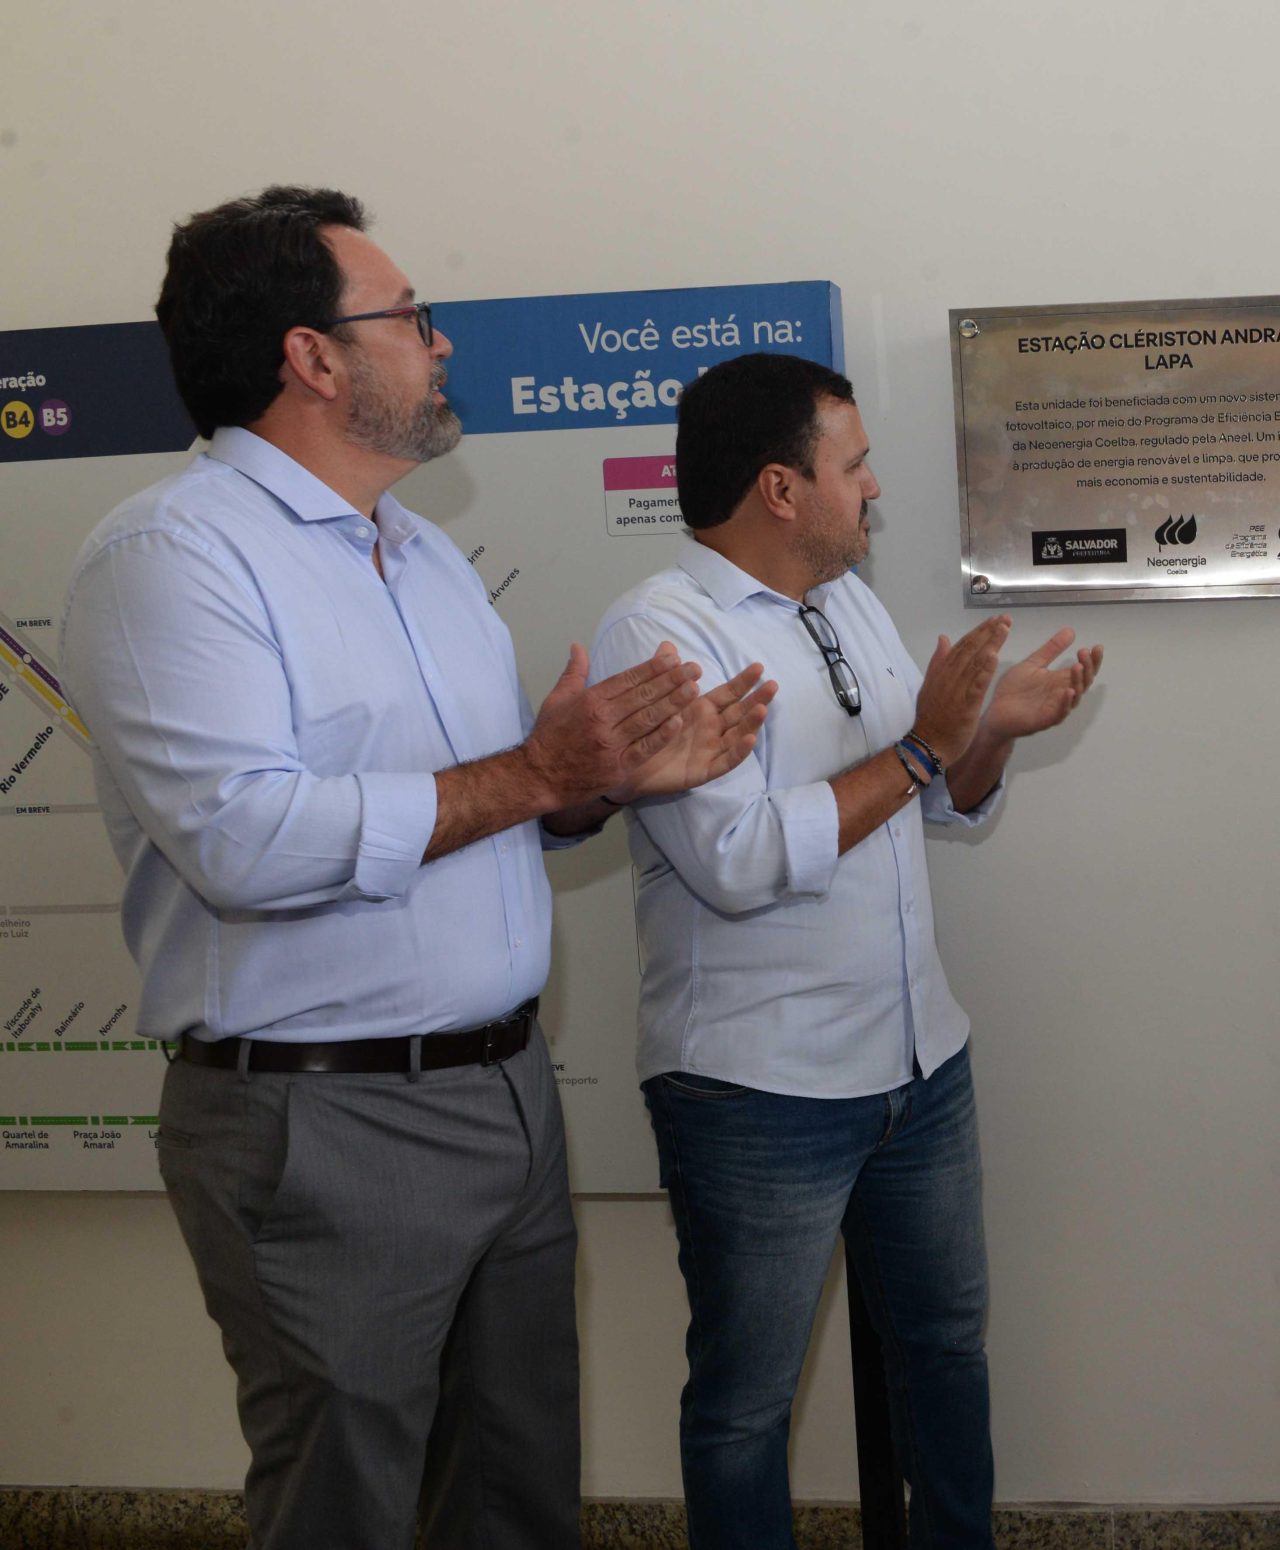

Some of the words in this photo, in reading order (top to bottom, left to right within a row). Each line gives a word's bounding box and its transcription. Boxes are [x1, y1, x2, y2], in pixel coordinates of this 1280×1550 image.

[578, 318, 660, 353] Você
[671, 314, 741, 349] está
[753, 320, 802, 345] na:
[1018, 332, 1104, 354] ESTAÇÃO
[1109, 329, 1217, 349] CLÉRISTON
[1144, 354, 1193, 370] LAPA
[510, 369, 684, 420] Estação
[1015, 401, 1040, 411] Esta
[1042, 398, 1086, 409] unidade
[1089, 397, 1103, 408] foi
[1105, 395, 1170, 408] beneficiada
[1172, 396, 1197, 405] com
[1200, 395, 1217, 404] um
[1219, 394, 1247, 403] novo
[5, 410, 31, 429] B4
[42, 407, 68, 427] B5
[1006, 419, 1074, 431] fotovoltaico,
[1076, 420, 1095, 430] por
[1098, 418, 1125, 428] meio
[1127, 416, 1142, 426] do
[1144, 415, 1198, 427] Programa
[1200, 413, 1215, 423] de
[1217, 411, 1272, 423] Eficiência
[1012, 441, 1027, 451] da
[1029, 438, 1093, 450] Neoenergia
[1095, 436, 1138, 448] Coelba,
[1140, 434, 1189, 447] regulado
[1192, 434, 1216, 445] pela
[1219, 432, 1254, 443] Aneel.
[1256, 432, 1275, 442] Um
[1022, 459, 1075, 472] produção
[1077, 458, 1092, 468] de
[1094, 456, 1135, 468] energia
[1137, 453, 1191, 466] renovável
[1193, 455, 1200, 464] e
[1238, 453, 1260, 464] que
[1076, 476, 1103, 488] mais
[1104, 475, 1159, 487] economia
[1161, 476, 1169, 484] e
[1171, 471, 1266, 484] sustentabilidade.
[616, 514, 656, 527] apenas
[1065, 539, 1118, 551] SALVADOR
[1147, 555, 1207, 568] Neoenergia
[490, 568, 520, 602] Árvores
[16, 620, 28, 628] EM
[28, 619, 52, 628] BREVE
[0, 773, 17, 795] Rio
[12, 726, 54, 774] Vermelho
[28, 806, 50, 814] BREVE
[4, 998, 33, 1031] Visconde
[31, 988, 41, 999] de
[54, 1001, 85, 1037] Balneário
[11, 1003, 42, 1039] Itaborahy
[98, 1004, 128, 1036] Noronha
[2, 1131, 35, 1139] Quartel
[38, 1130, 49, 1139] de
[73, 1130, 98, 1141] Praça
[100, 1130, 121, 1139] João
[5, 1141, 49, 1149] Amaralina
[83, 1141, 114, 1149] Amaral
